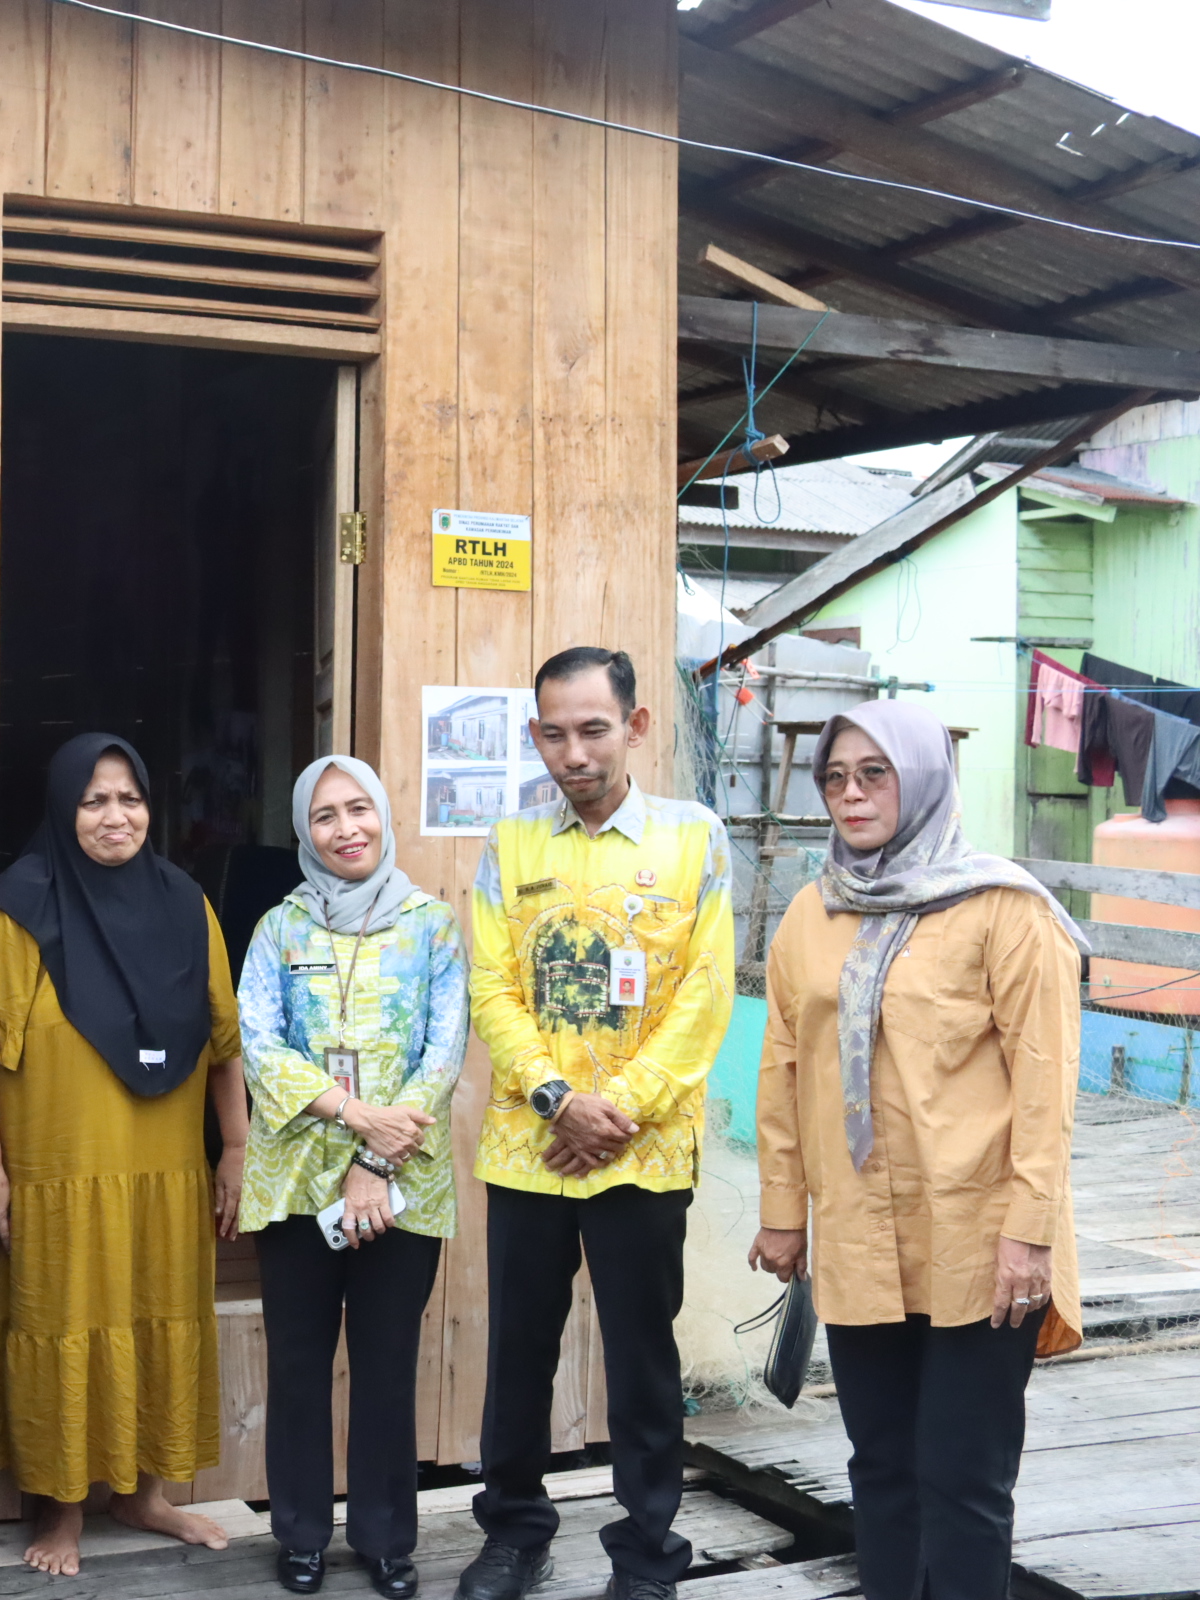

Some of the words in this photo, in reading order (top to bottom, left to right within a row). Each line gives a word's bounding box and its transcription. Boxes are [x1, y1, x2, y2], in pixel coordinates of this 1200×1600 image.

[455, 539, 507, 557] RTLH
[448, 557, 467, 566] APBD
[470, 558, 493, 567] TAHUN
[496, 560, 514, 568] 2024
